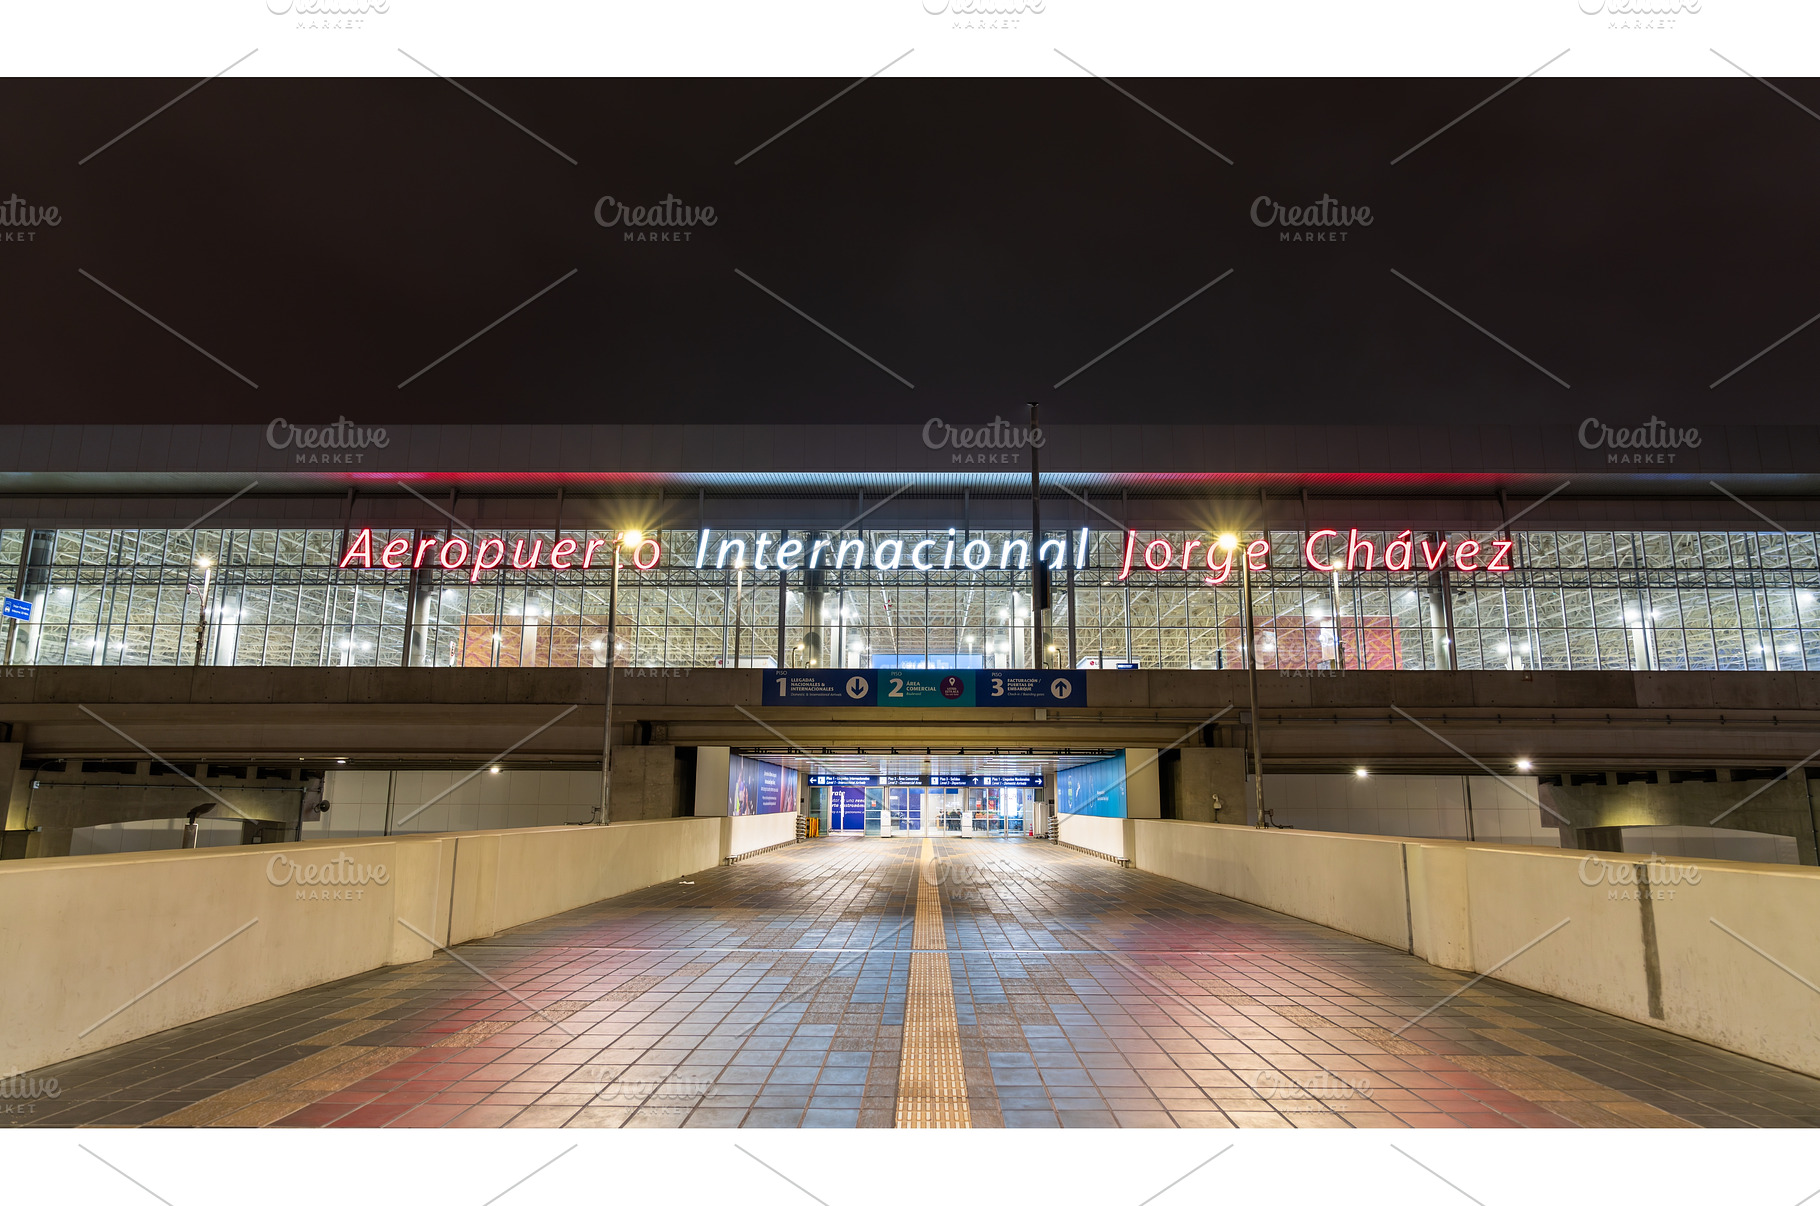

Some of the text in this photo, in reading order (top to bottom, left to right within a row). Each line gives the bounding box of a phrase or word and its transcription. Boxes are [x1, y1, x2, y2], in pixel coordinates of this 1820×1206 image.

[695, 527, 1089, 571] Internacional
[1118, 528, 1270, 584] Jorge
[1305, 527, 1513, 572] Chávez
[776, 678, 786, 696] 1
[888, 678, 904, 697] 2
[991, 678, 1004, 697] 3
